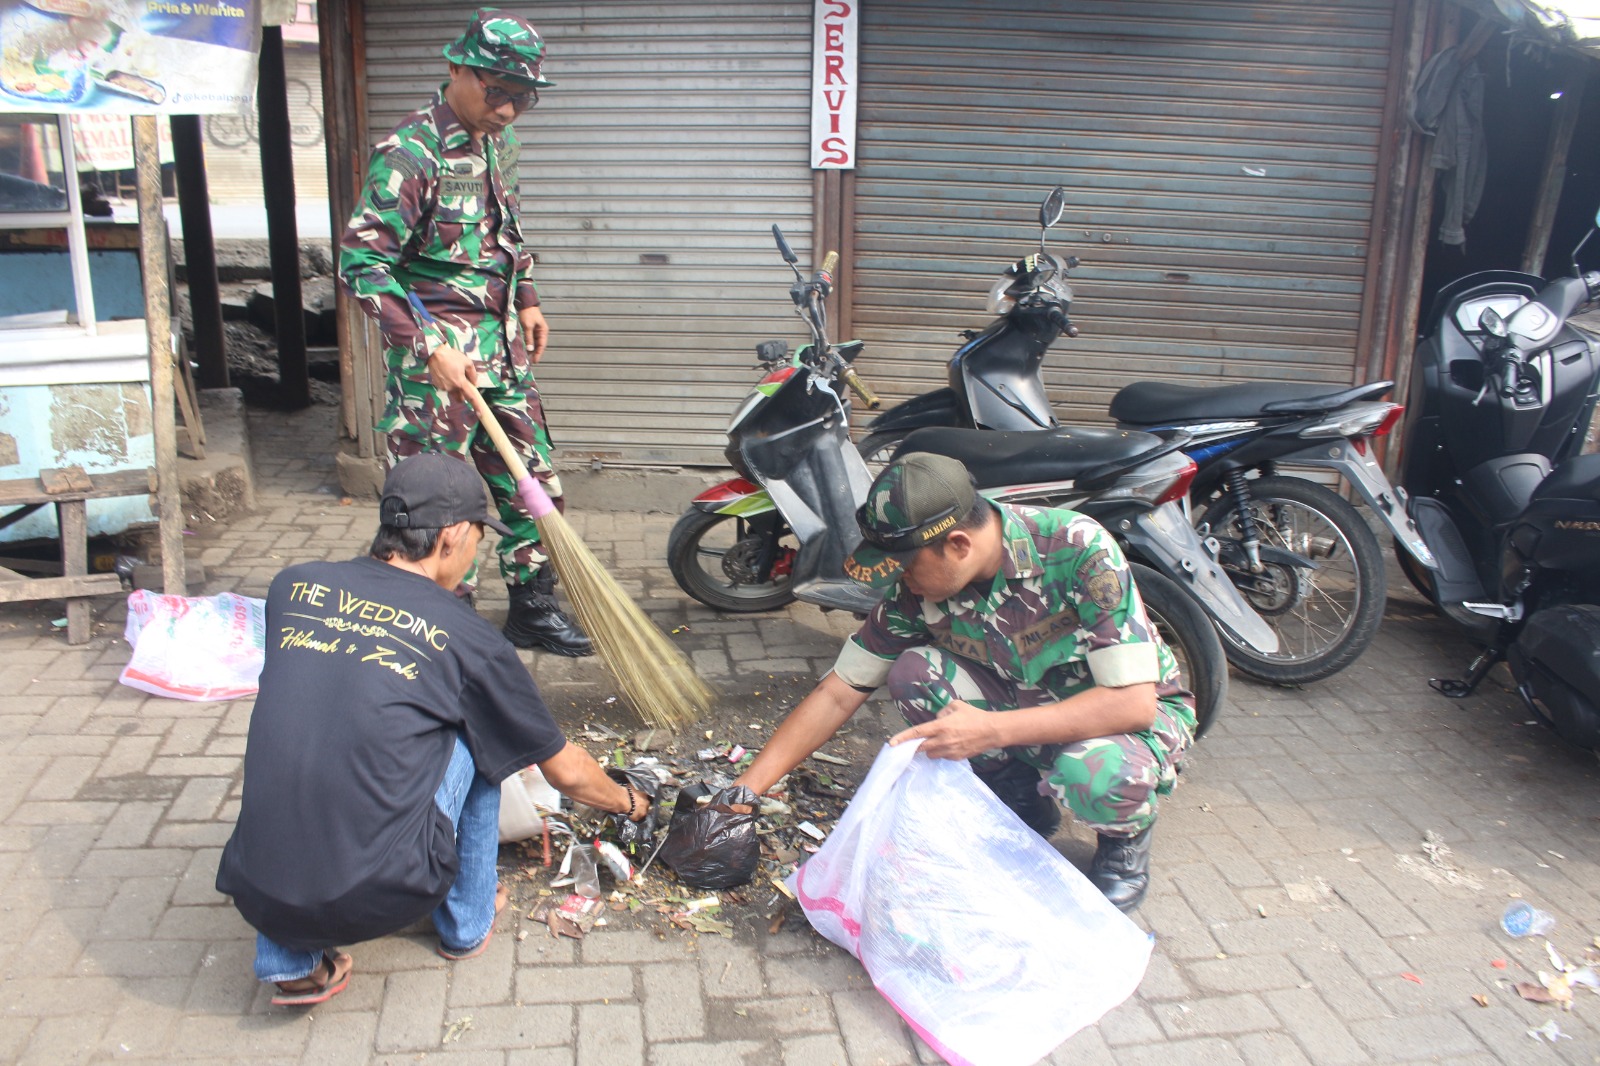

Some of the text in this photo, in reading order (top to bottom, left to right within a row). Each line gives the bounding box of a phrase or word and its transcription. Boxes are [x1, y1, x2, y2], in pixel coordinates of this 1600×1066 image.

[147, 1, 245, 18] Pria & Wanita
[818, 0, 851, 167] SERVIS
[445, 181, 483, 192] SAYUTI
[922, 515, 957, 541] BABINSA
[290, 582, 450, 652] THE WEDDING
[280, 626, 342, 654] Hikmah
[361, 645, 419, 680] Zaki
